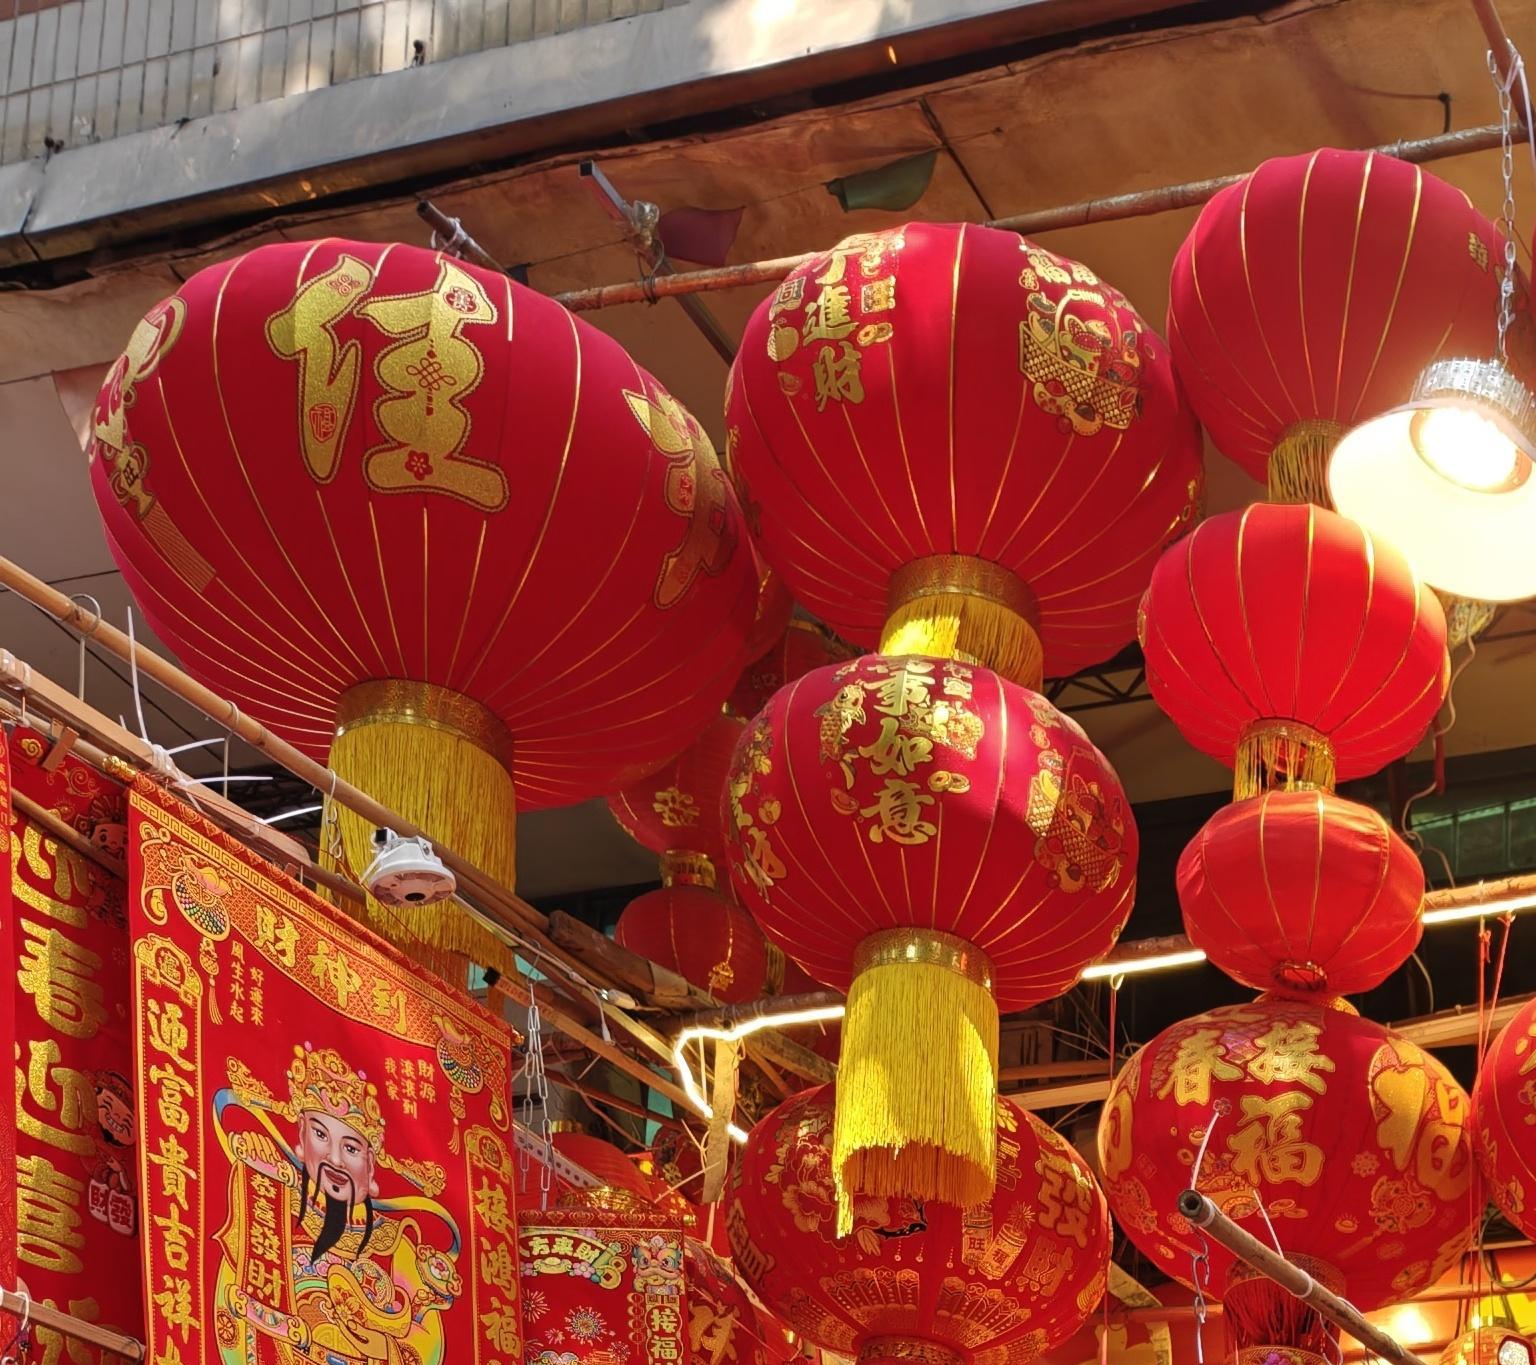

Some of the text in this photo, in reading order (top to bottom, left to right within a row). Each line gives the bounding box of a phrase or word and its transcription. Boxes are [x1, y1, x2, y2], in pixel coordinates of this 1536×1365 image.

[859, 656, 937, 845] 事如意
[254, 904, 408, 1036] 財神到
